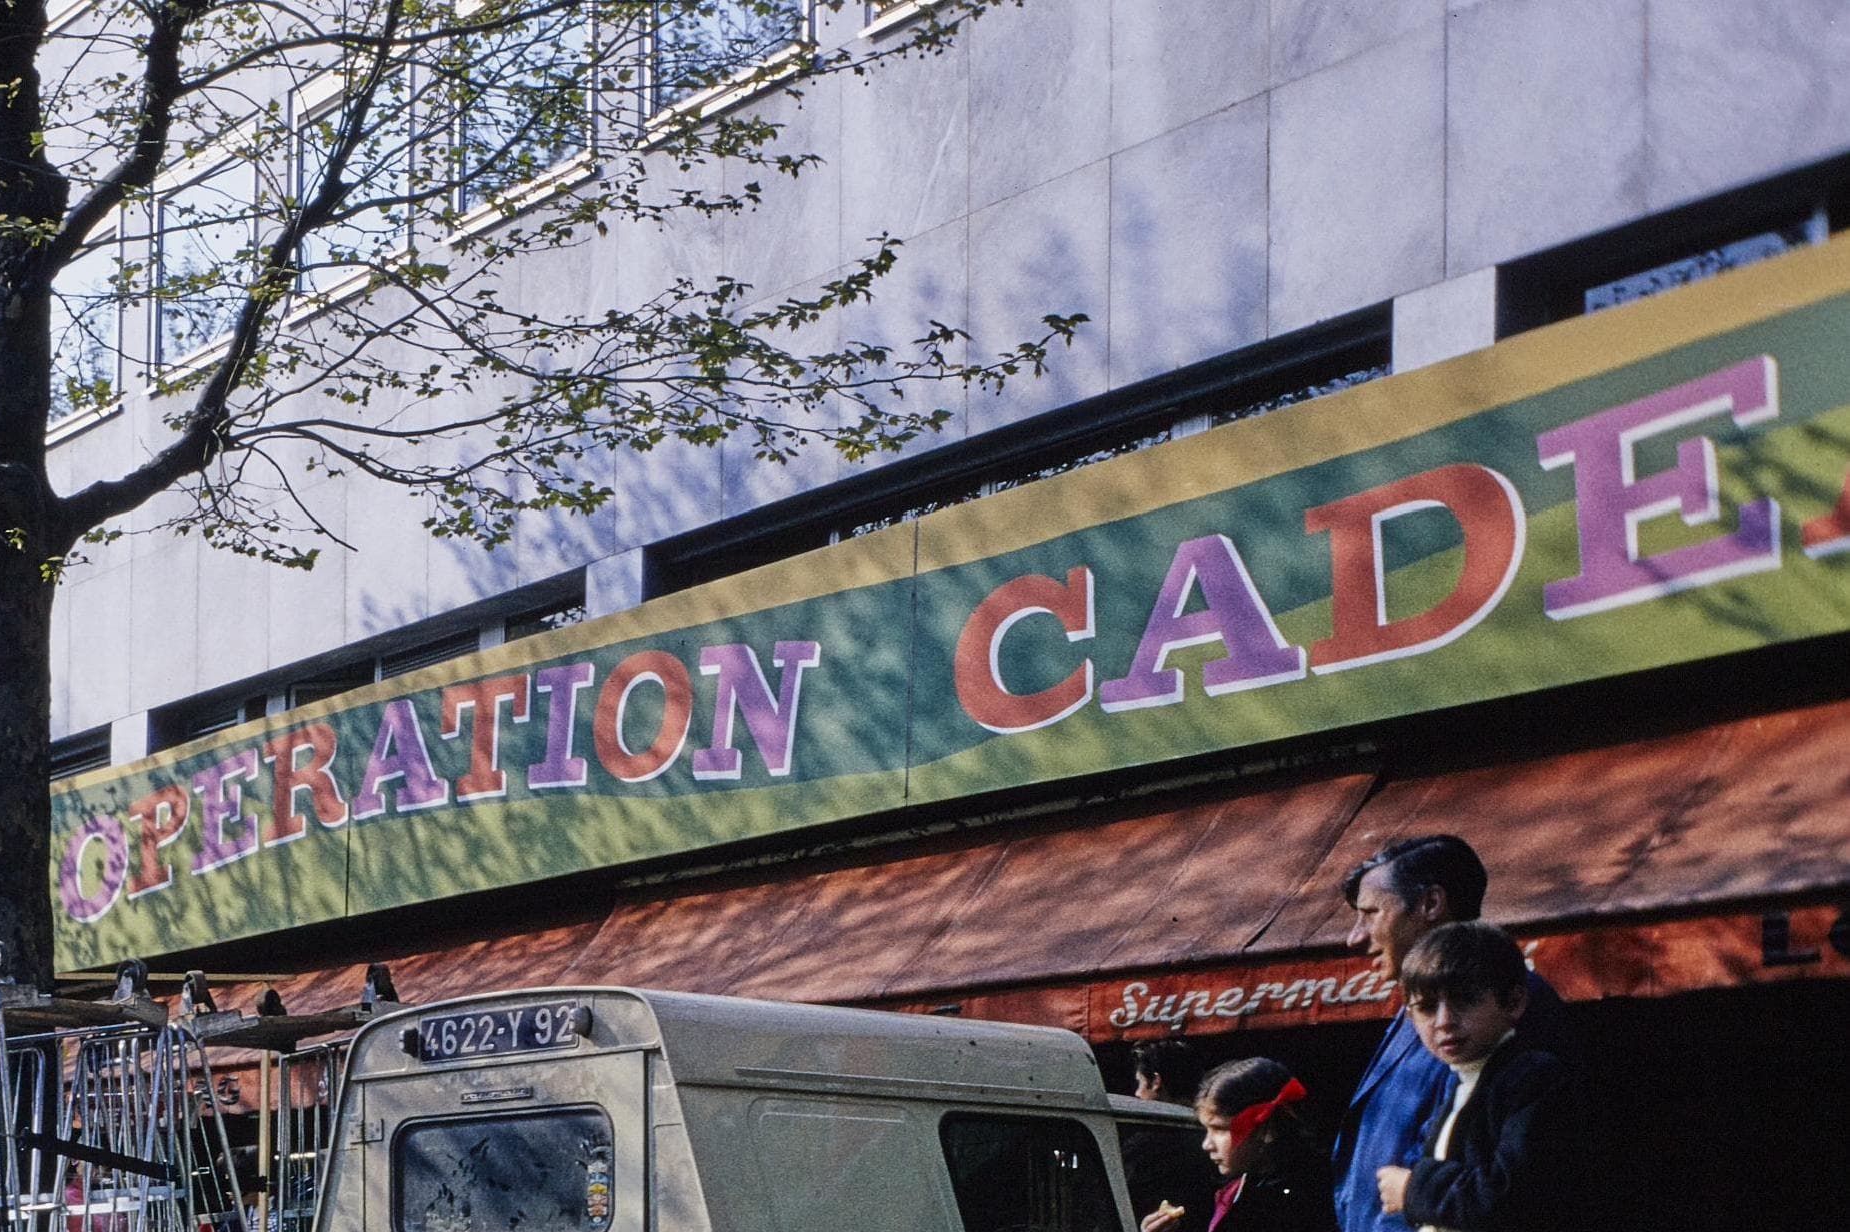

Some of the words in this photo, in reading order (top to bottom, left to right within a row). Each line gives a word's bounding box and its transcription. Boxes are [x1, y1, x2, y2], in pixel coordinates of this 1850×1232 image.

[58, 640, 821, 923] OPERATION
[954, 354, 1850, 735] CADE
[535, 1005, 574, 1045] 92
